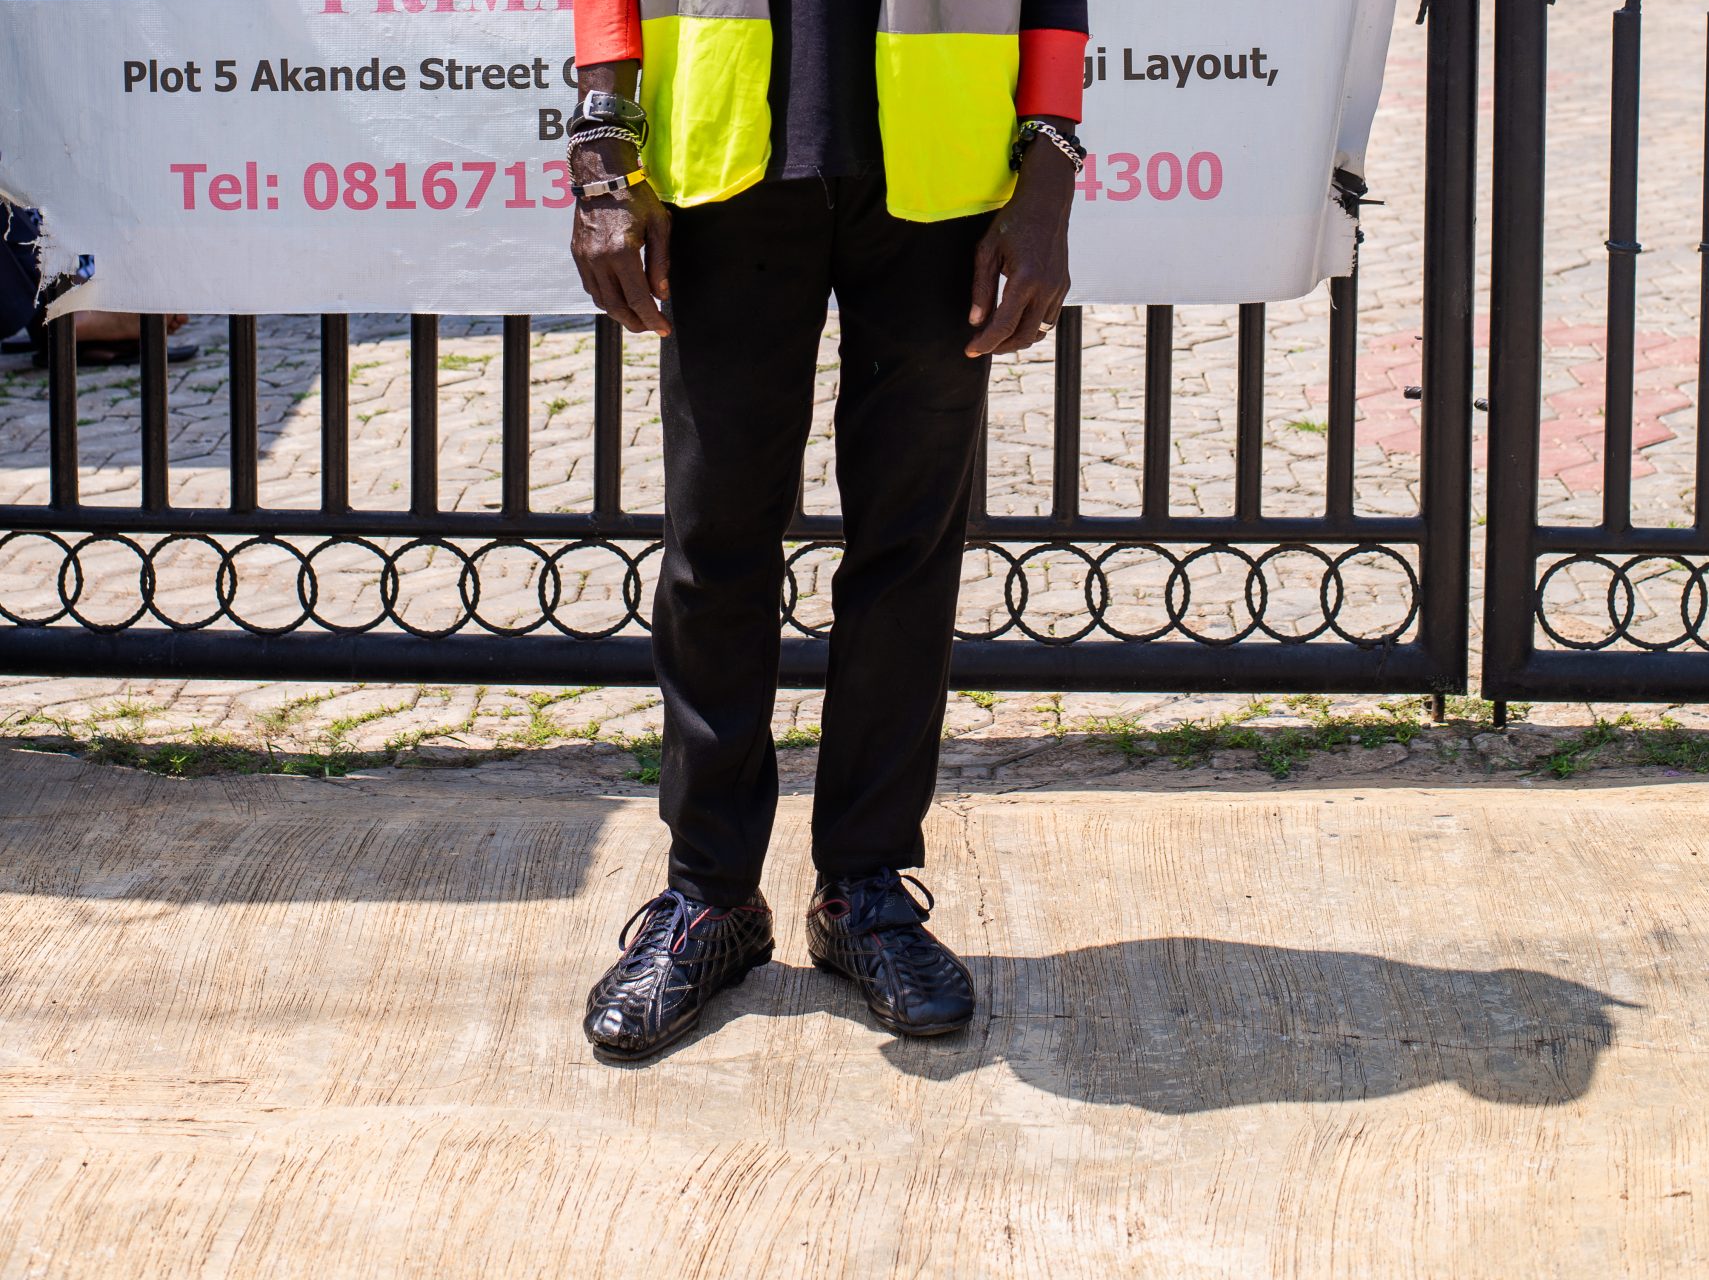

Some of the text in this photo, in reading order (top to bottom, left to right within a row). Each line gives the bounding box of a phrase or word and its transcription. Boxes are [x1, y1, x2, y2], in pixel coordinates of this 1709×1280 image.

[123, 59, 202, 93] Plot
[214, 60, 238, 92] 5
[250, 58, 406, 92] Akande
[419, 56, 550, 91] Street
[1122, 46, 1279, 88] Layout,
[170, 162, 280, 211] Tel:
[302, 160, 577, 211] 0816713
